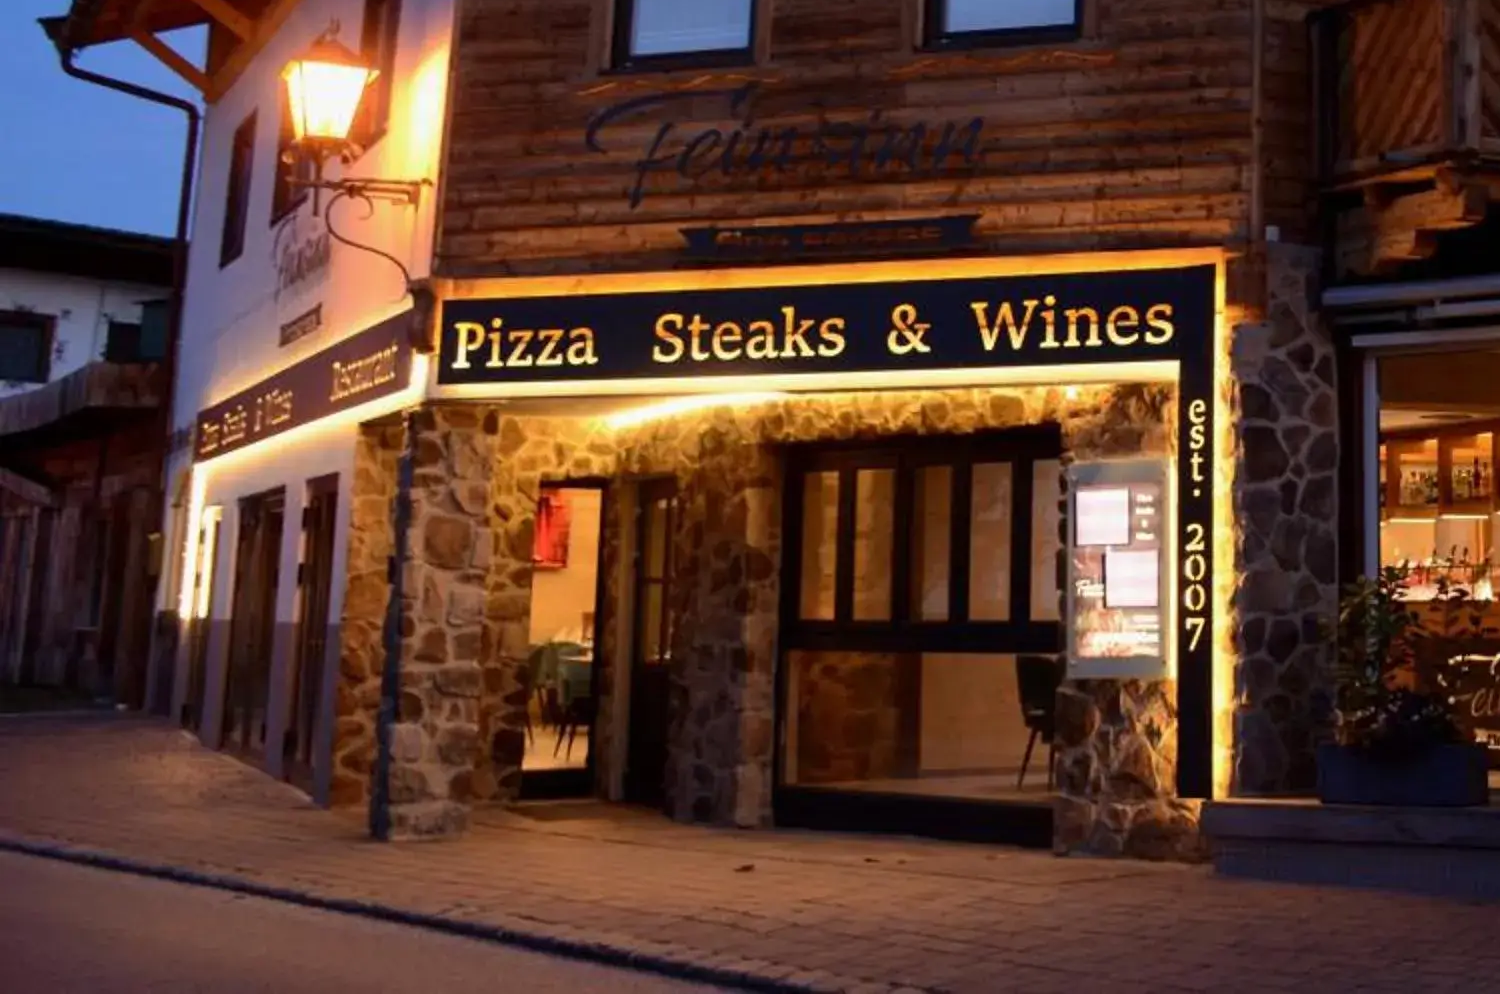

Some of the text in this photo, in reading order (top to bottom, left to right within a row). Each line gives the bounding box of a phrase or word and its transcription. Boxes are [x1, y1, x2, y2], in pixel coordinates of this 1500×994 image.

[585, 82, 987, 210] Feinsinn
[451, 295, 1175, 370] Pizza Steaks & Wines
[1184, 398, 1206, 653] est. 2007
